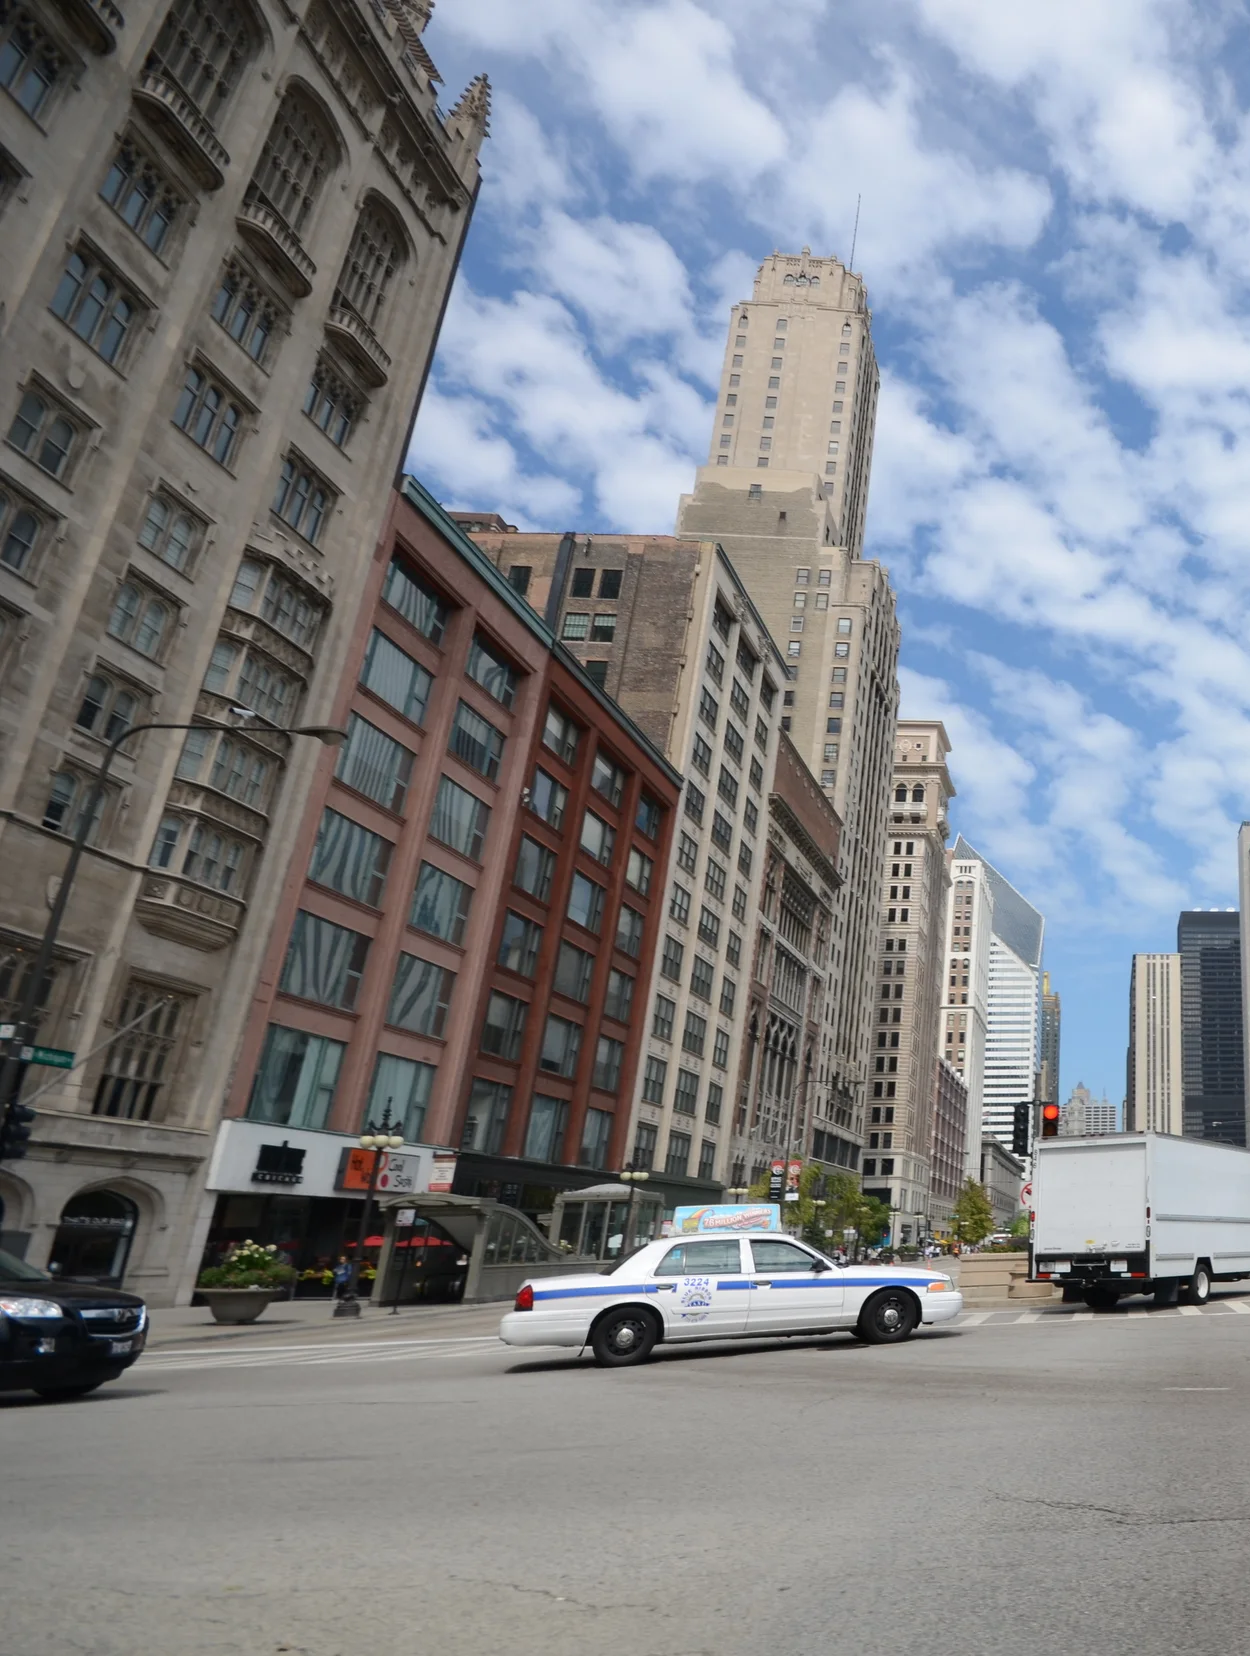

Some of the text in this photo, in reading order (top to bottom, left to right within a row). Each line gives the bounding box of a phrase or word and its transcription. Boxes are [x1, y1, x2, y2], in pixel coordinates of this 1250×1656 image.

[257, 1173, 304, 1184] CHICAGO
[715, 1214, 743, 1226] MILLION
[744, 1208, 772, 1220] WINNERS
[683, 1277, 710, 1287] 3224
